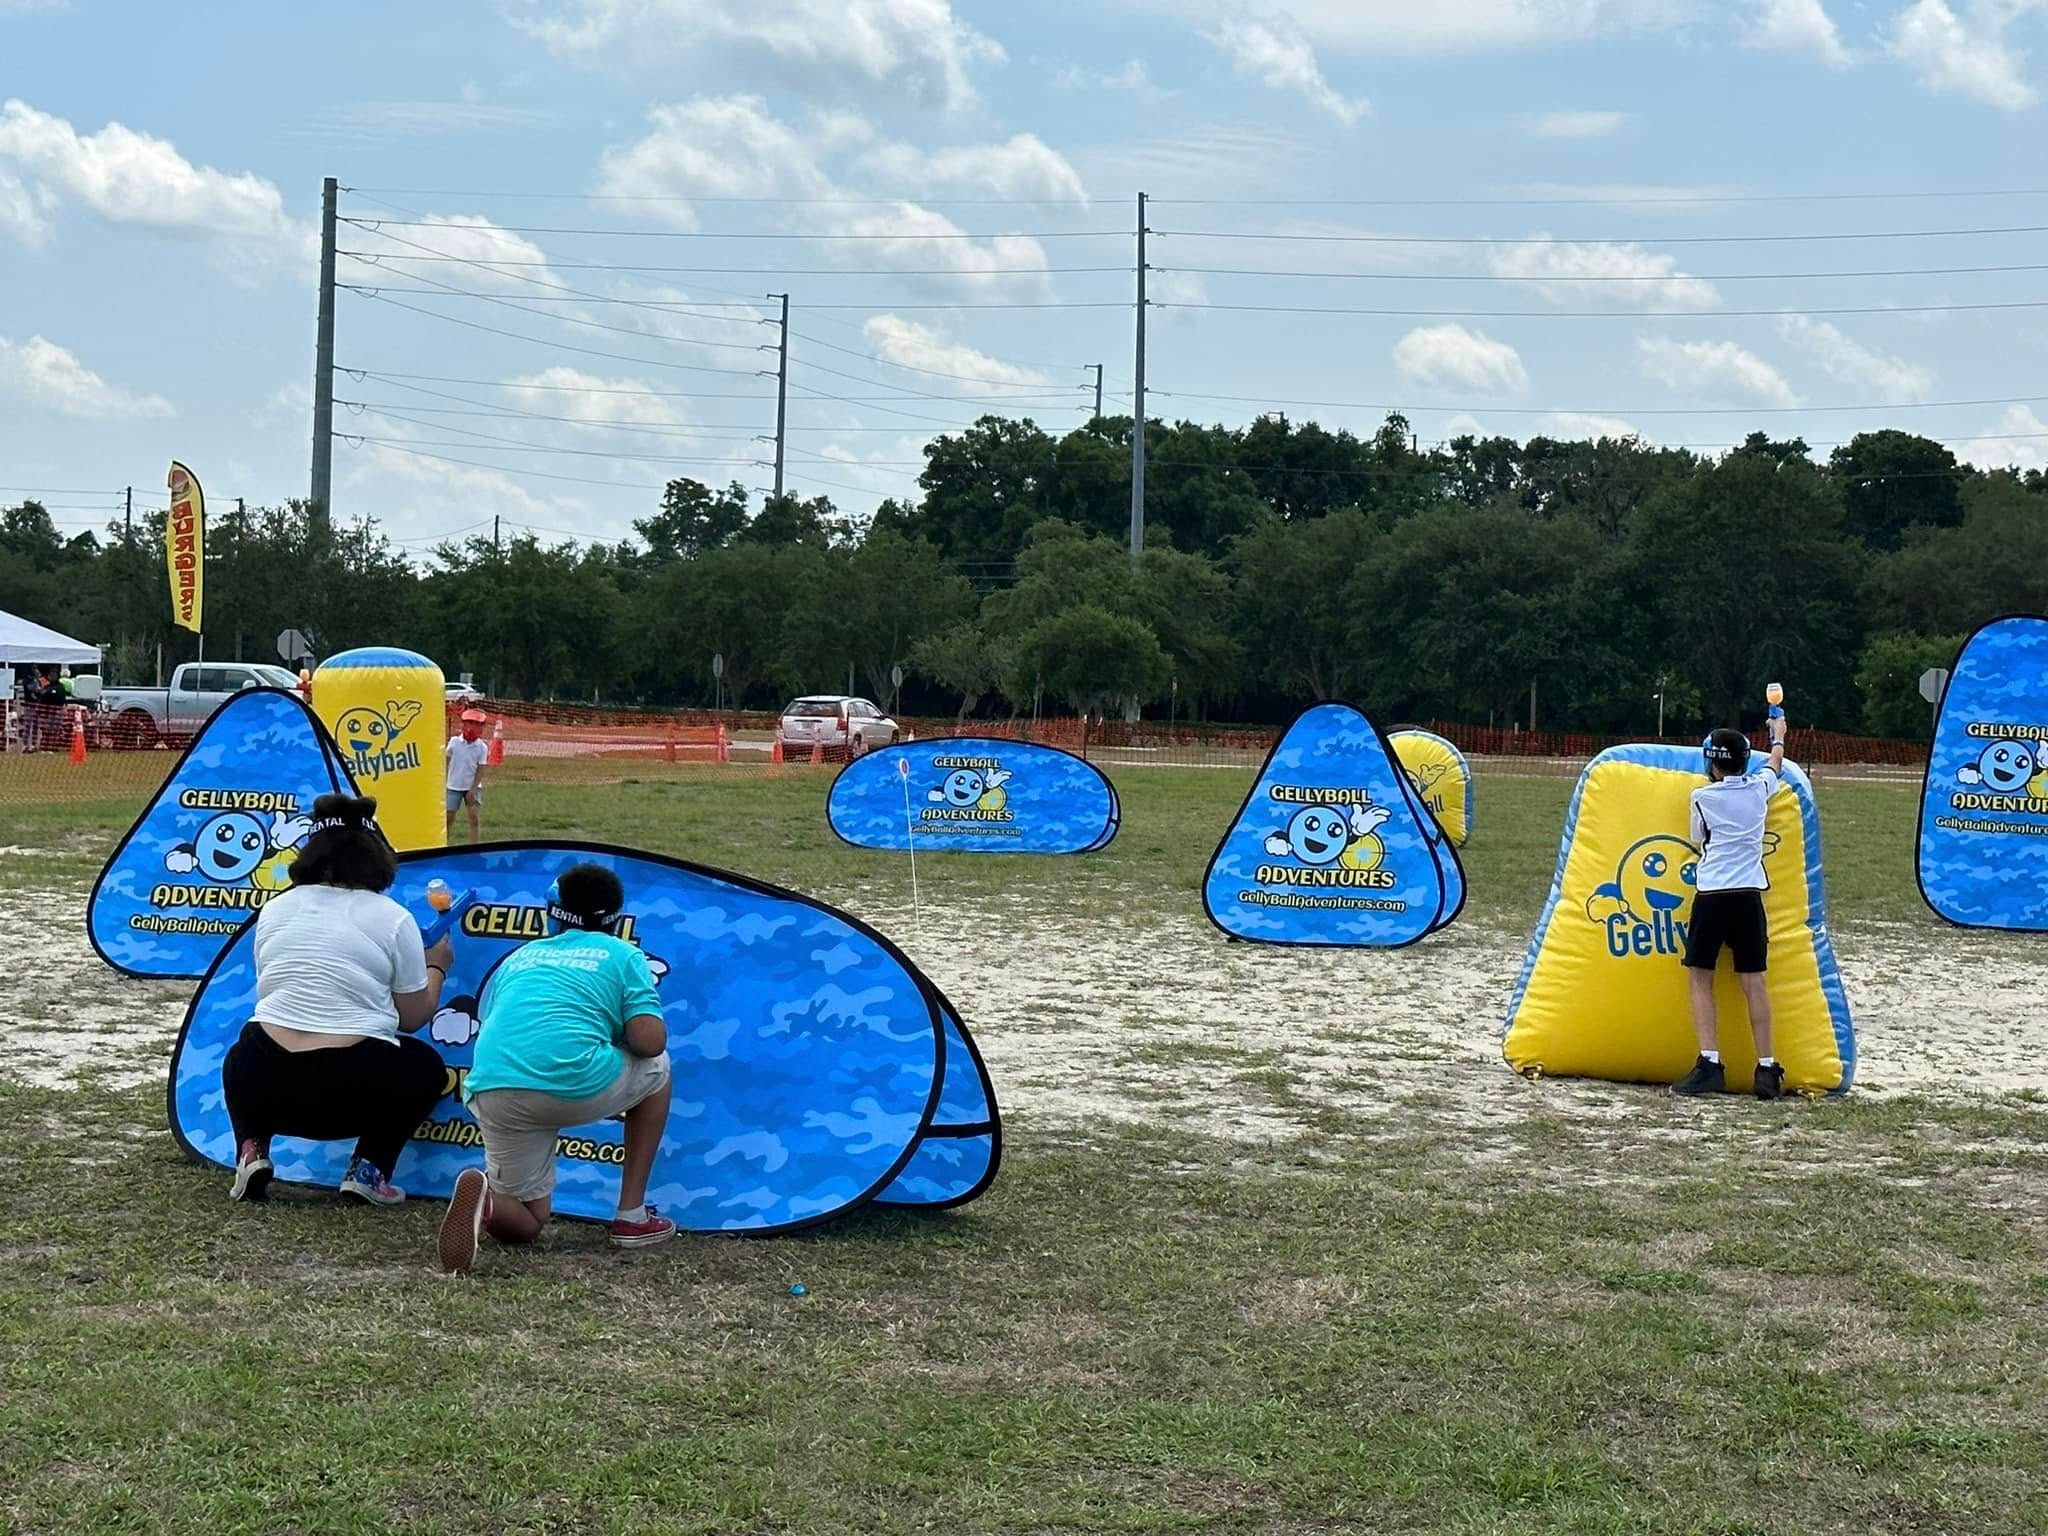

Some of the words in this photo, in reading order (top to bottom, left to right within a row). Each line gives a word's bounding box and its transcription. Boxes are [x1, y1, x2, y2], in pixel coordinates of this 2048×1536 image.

[1967, 723, 2048, 740] GELLYBAL
[348, 743, 421, 781] ellyball
[934, 757, 1000, 768] GELLYBALL
[182, 790, 299, 811] GELLYBALL
[1271, 786, 1372, 804] GELLYBALL
[1952, 793, 2048, 812] ADVENTU
[921, 809, 1014, 821] ADVENTURES
[1935, 817, 2048, 834] GellyBallAdventur
[1257, 866, 1394, 888] ADVENTURES
[152, 886, 281, 909] ADVENTU
[1239, 891, 1405, 913] GellyBallAdventures.com
[130, 916, 242, 934] GellyBallAdve
[1607, 909, 1689, 957] Gelly
